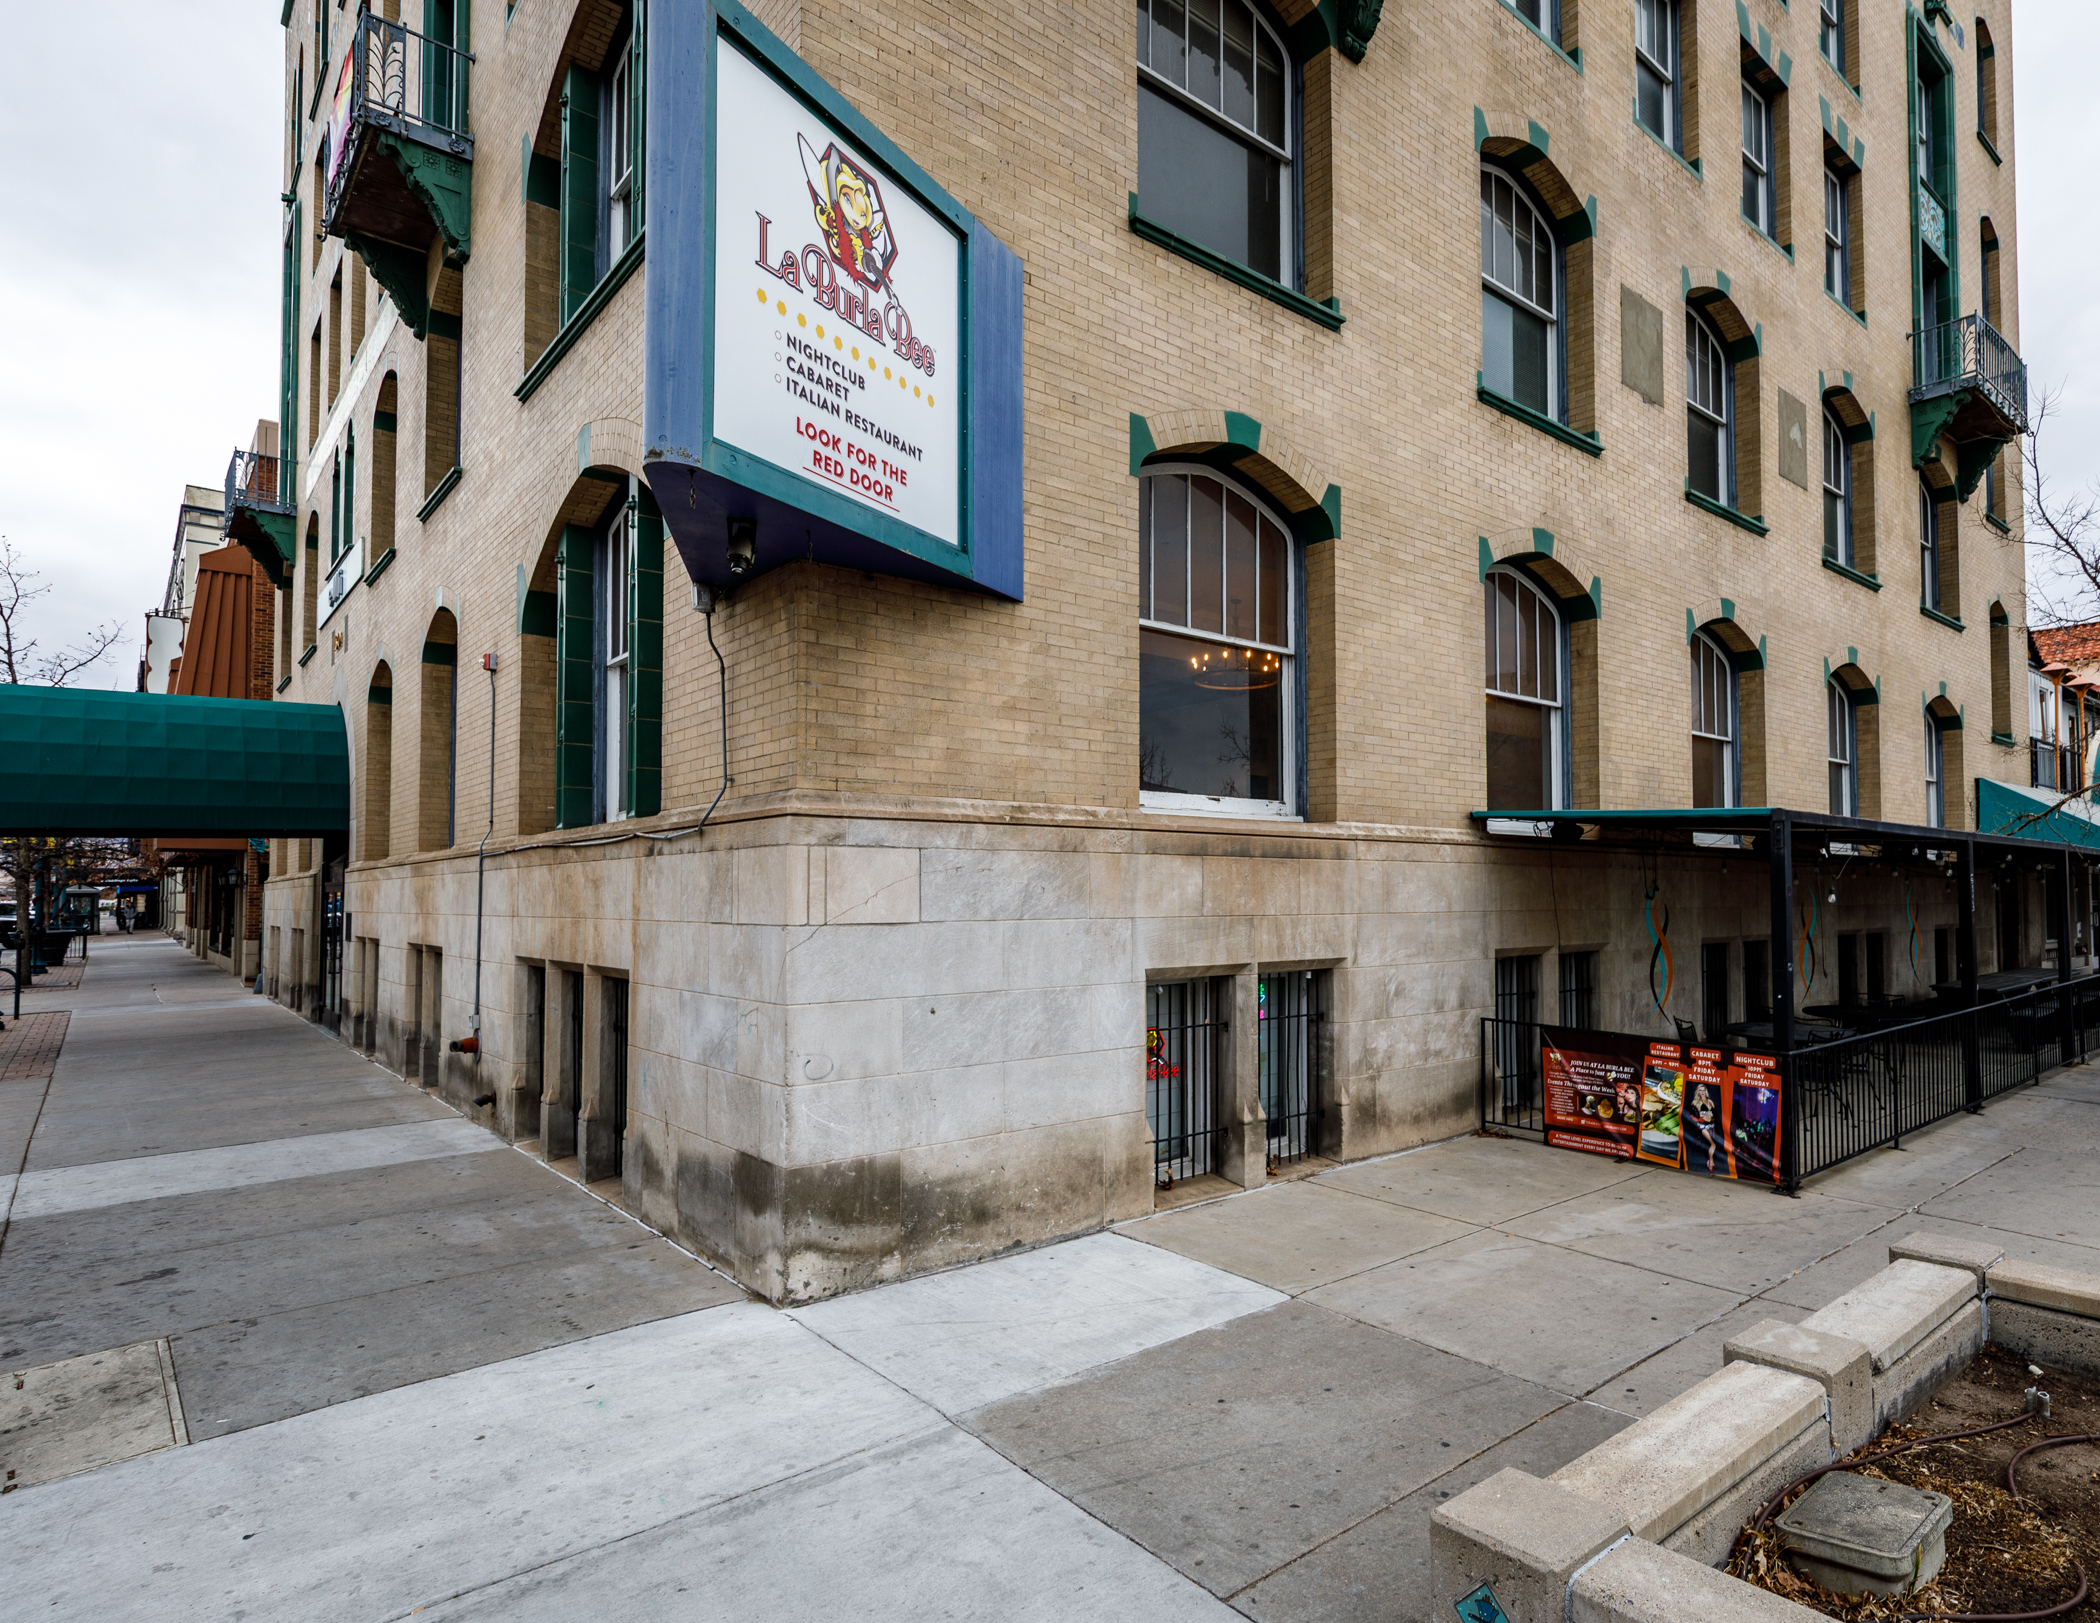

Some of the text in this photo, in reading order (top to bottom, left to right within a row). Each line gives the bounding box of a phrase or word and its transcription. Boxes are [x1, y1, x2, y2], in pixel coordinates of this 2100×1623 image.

[755, 210, 935, 377] La Burla Bee
[786, 332, 865, 391] NIGHTCLUB
[786, 356, 849, 402] CABARET
[786, 376, 923, 462] ITALIAN RESTAURANT
[796, 416, 907, 487] LOOK FOR THE
[813, 449, 893, 502] RED DOOR
[1651, 1049, 1680, 1058] RESTAURANT
[1691, 1050, 1720, 1060] CABARET
[1698, 1059, 1711, 1067] 8PM
[1736, 1056, 1774, 1067] NIGHTCLUB
[1605, 1064, 1623, 1072] BURLA
[1693, 1066, 1716, 1075] FRIDAY
[1747, 1065, 1762, 1073] 10PM
[1688, 1073, 1721, 1083] SATURDAY
[1744, 1072, 1765, 1080] FRIDAY
[1547, 1078, 1564, 1086] Events
[1740, 1078, 1770, 1087] SATURDAY
